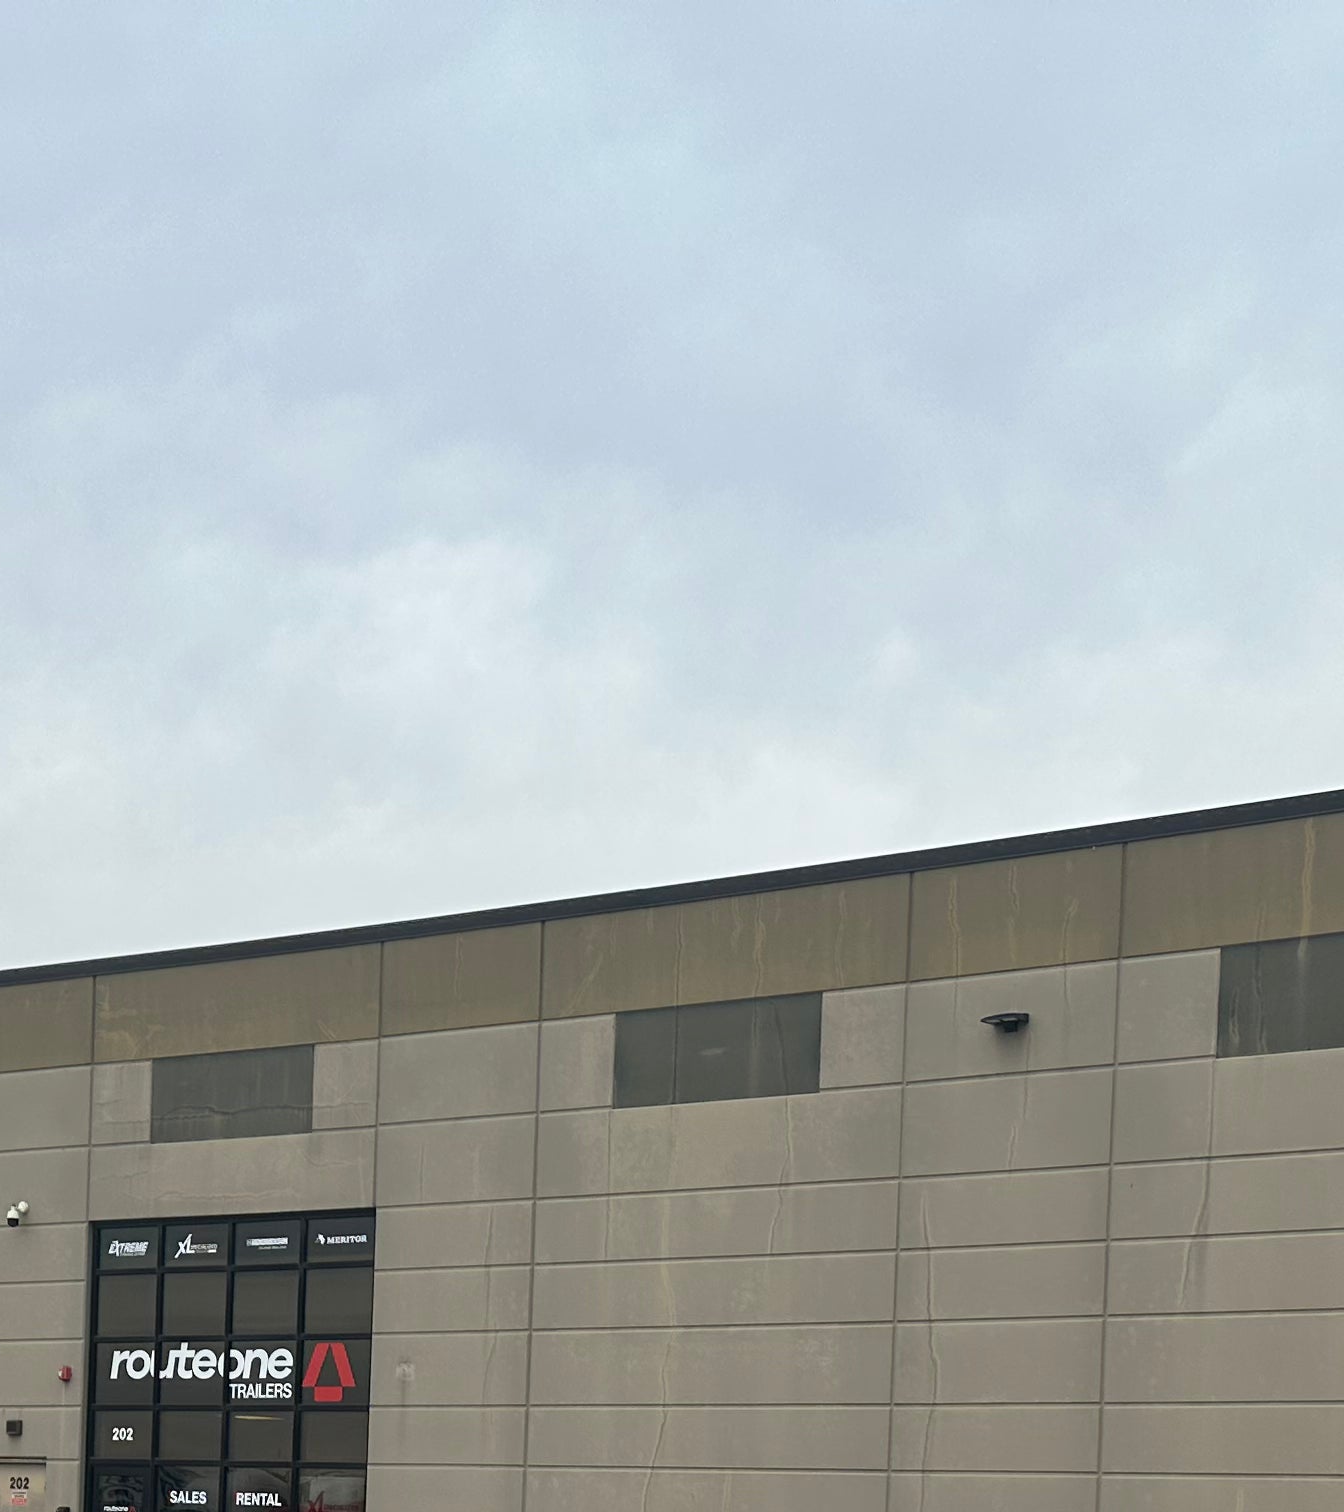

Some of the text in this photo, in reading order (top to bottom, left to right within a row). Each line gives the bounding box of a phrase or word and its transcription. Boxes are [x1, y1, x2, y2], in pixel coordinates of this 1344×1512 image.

[326, 1235, 367, 1244] MERITOR
[110, 1342, 294, 1380] routeone
[230, 1383, 293, 1399] TRAILERS
[112, 1427, 134, 1441] 202
[9, 1476, 30, 1490] 202
[169, 1490, 282, 1507] SALES RENTAL
